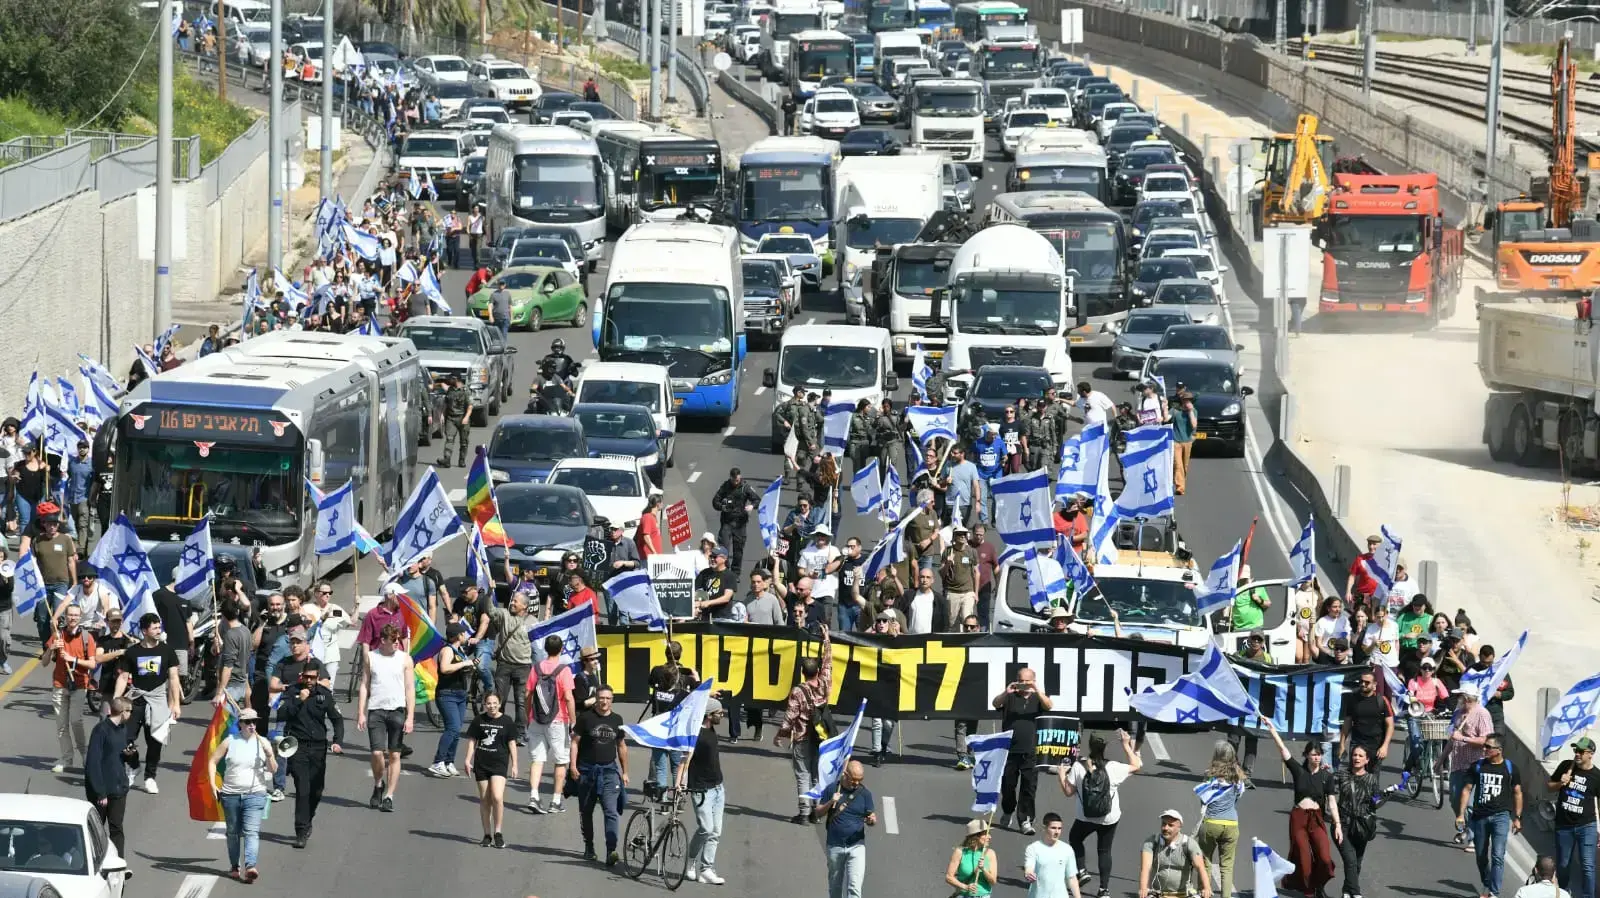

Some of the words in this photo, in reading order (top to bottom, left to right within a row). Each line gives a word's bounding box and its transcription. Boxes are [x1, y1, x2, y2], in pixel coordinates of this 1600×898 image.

[1355, 261, 1391, 269] SCANIA
[1530, 254, 1582, 264] DOOSAN
[160, 410, 179, 429] 116
[182, 413, 201, 429] יפו
[203, 414, 237, 431] אביב
[240, 416, 259, 432] תל
[429, 501, 444, 525] SOS
[969, 646, 1206, 712] התנגד
